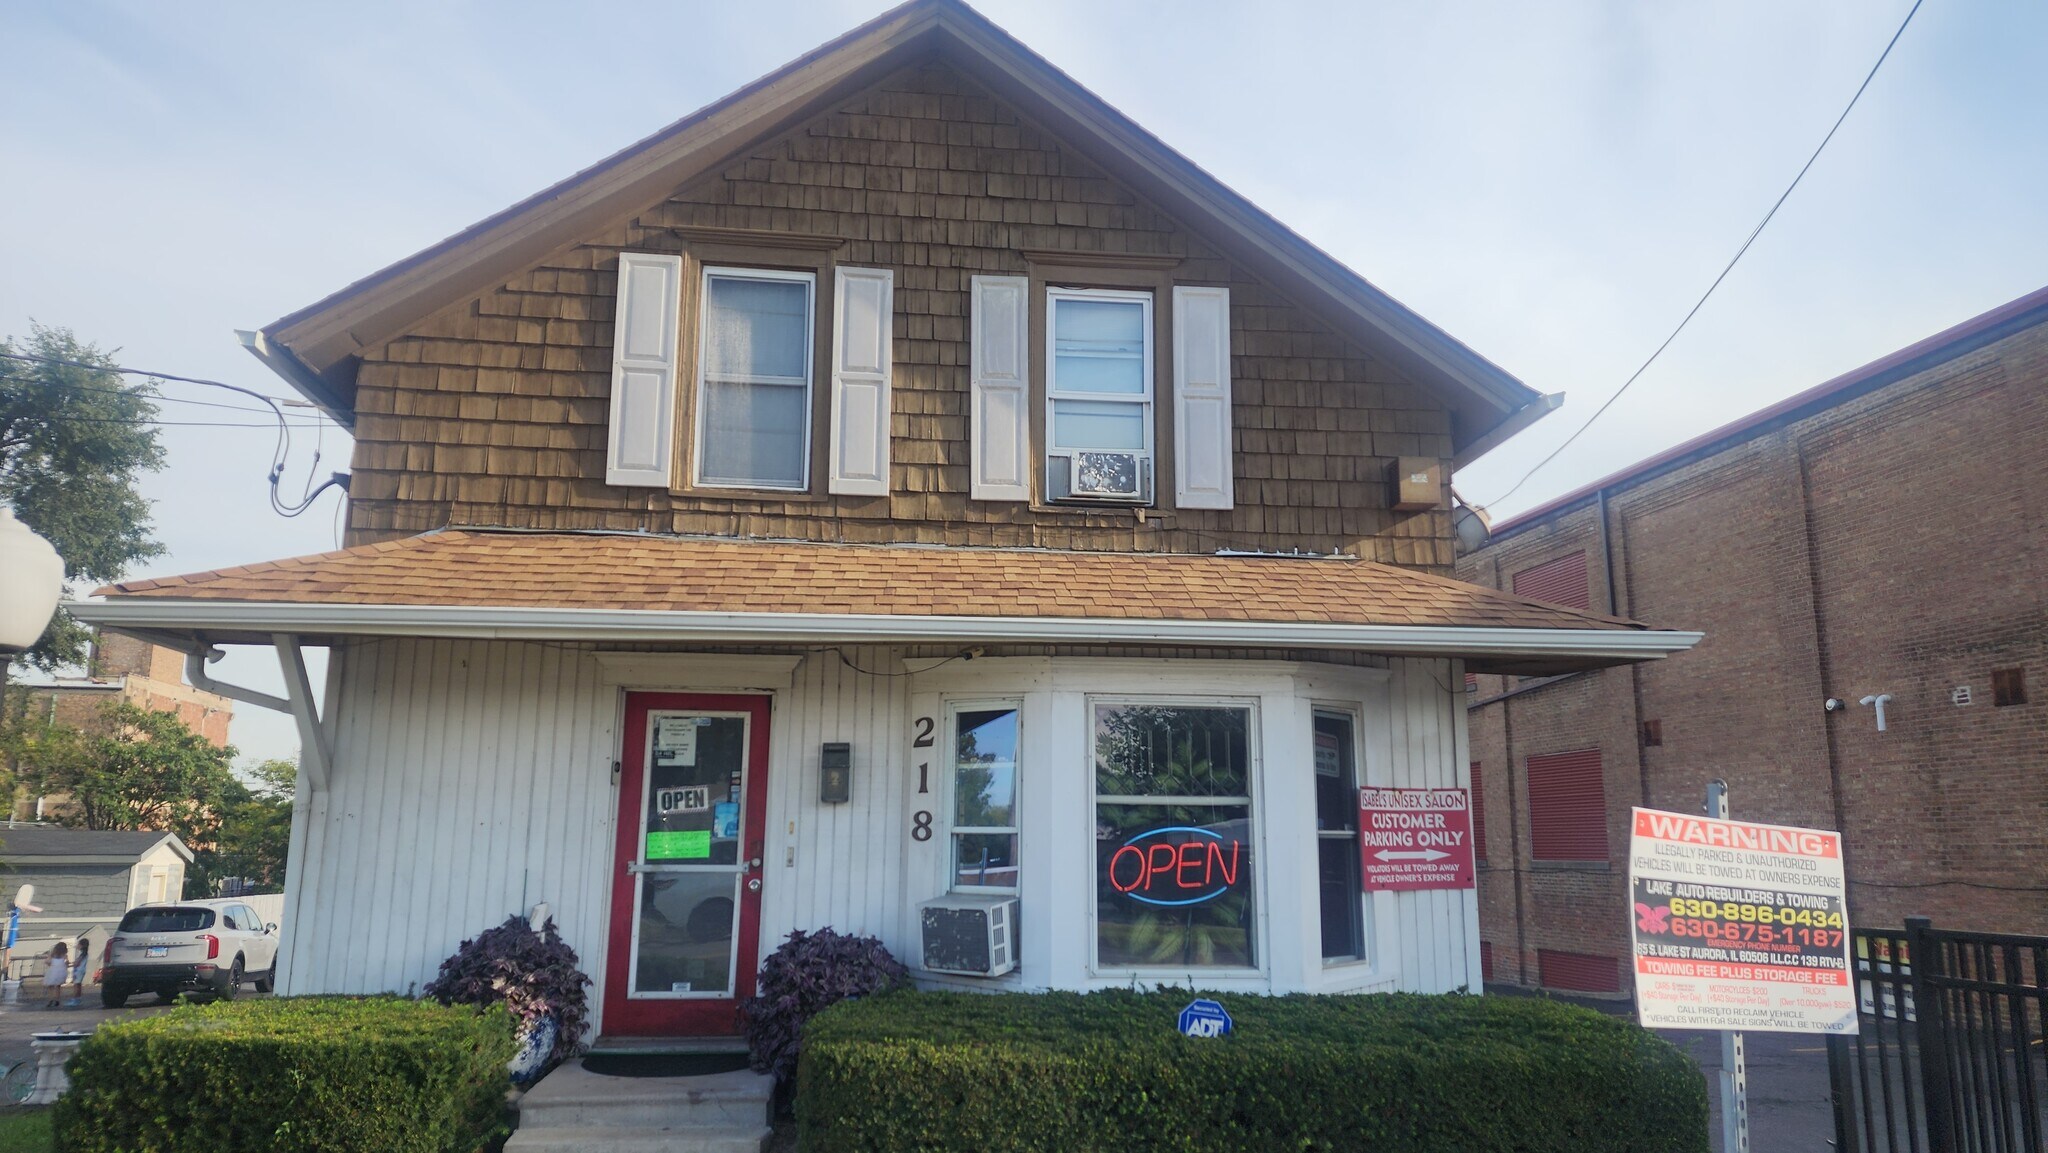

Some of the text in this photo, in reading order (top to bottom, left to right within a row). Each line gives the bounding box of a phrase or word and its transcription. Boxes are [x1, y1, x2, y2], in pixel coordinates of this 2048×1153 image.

[911, 716, 935, 842] 218
[661, 790, 705, 811] OPEN
[1362, 793, 1464, 808] ISABEL'S UNISEX SALON
[1371, 812, 1447, 829] CUSTOMER
[1364, 830, 1464, 847] PARKING ONLY
[1649, 814, 1824, 856] WARNING
[1109, 839, 1240, 892] OPEN
[1655, 842, 1817, 871] ILLEGALLY PARKED & UNAUTHORIZED
[1366, 863, 1460, 873] VIOLATORS WILL BE TOWED AWAY
[1370, 873, 1456, 884] AT VEHICLE OWNER'S EXPENSE
[1634, 856, 1841, 889] VEHICLES WILL BE TOWED AT OWNERS EXPENSE
[1646, 879, 1829, 910] LAKE AUTO REBUILDERS & TOWING
[1669, 897, 1843, 929] 630-896-0434
[1671, 917, 1843, 948] 630-675-1187
[1649, 943, 1658, 957] S.
[1659, 944, 1680, 958] LAKE
[1679, 946, 1691, 959] ST
[1692, 947, 1730, 962] AURORA,
[1730, 950, 1739, 962] IL
[1739, 950, 1769, 964] 60506
[1800, 955, 1818, 967] 139
[1706, 938, 1801, 953] EMERGENCY PHONE NUMBER
[1645, 960, 1838, 985] TOWING FEE PLUS STORAGE FEE
[1679, 992, 1689, 1001] Per
[1725, 995, 1746, 1006] Storage
[1747, 996, 1757, 1004] Per
[1802, 986, 1827, 996] TRUCKS
[1677, 1005, 1805, 1019] CALL FIRST TO RECLAIM VEHICLE
[1187, 1017, 1224, 1038] ADT
[1687, 1016, 1709, 1025] WITH
[1710, 1017, 1725, 1025] FOR
[1727, 1017, 1747, 1026] SALE
[1748, 1018, 1772, 1027] SIGNS
[1773, 1019, 1796, 1028] WILL
[1797, 1020, 1809, 1029] BE
[1811, 1021, 1845, 1031] TOWED
